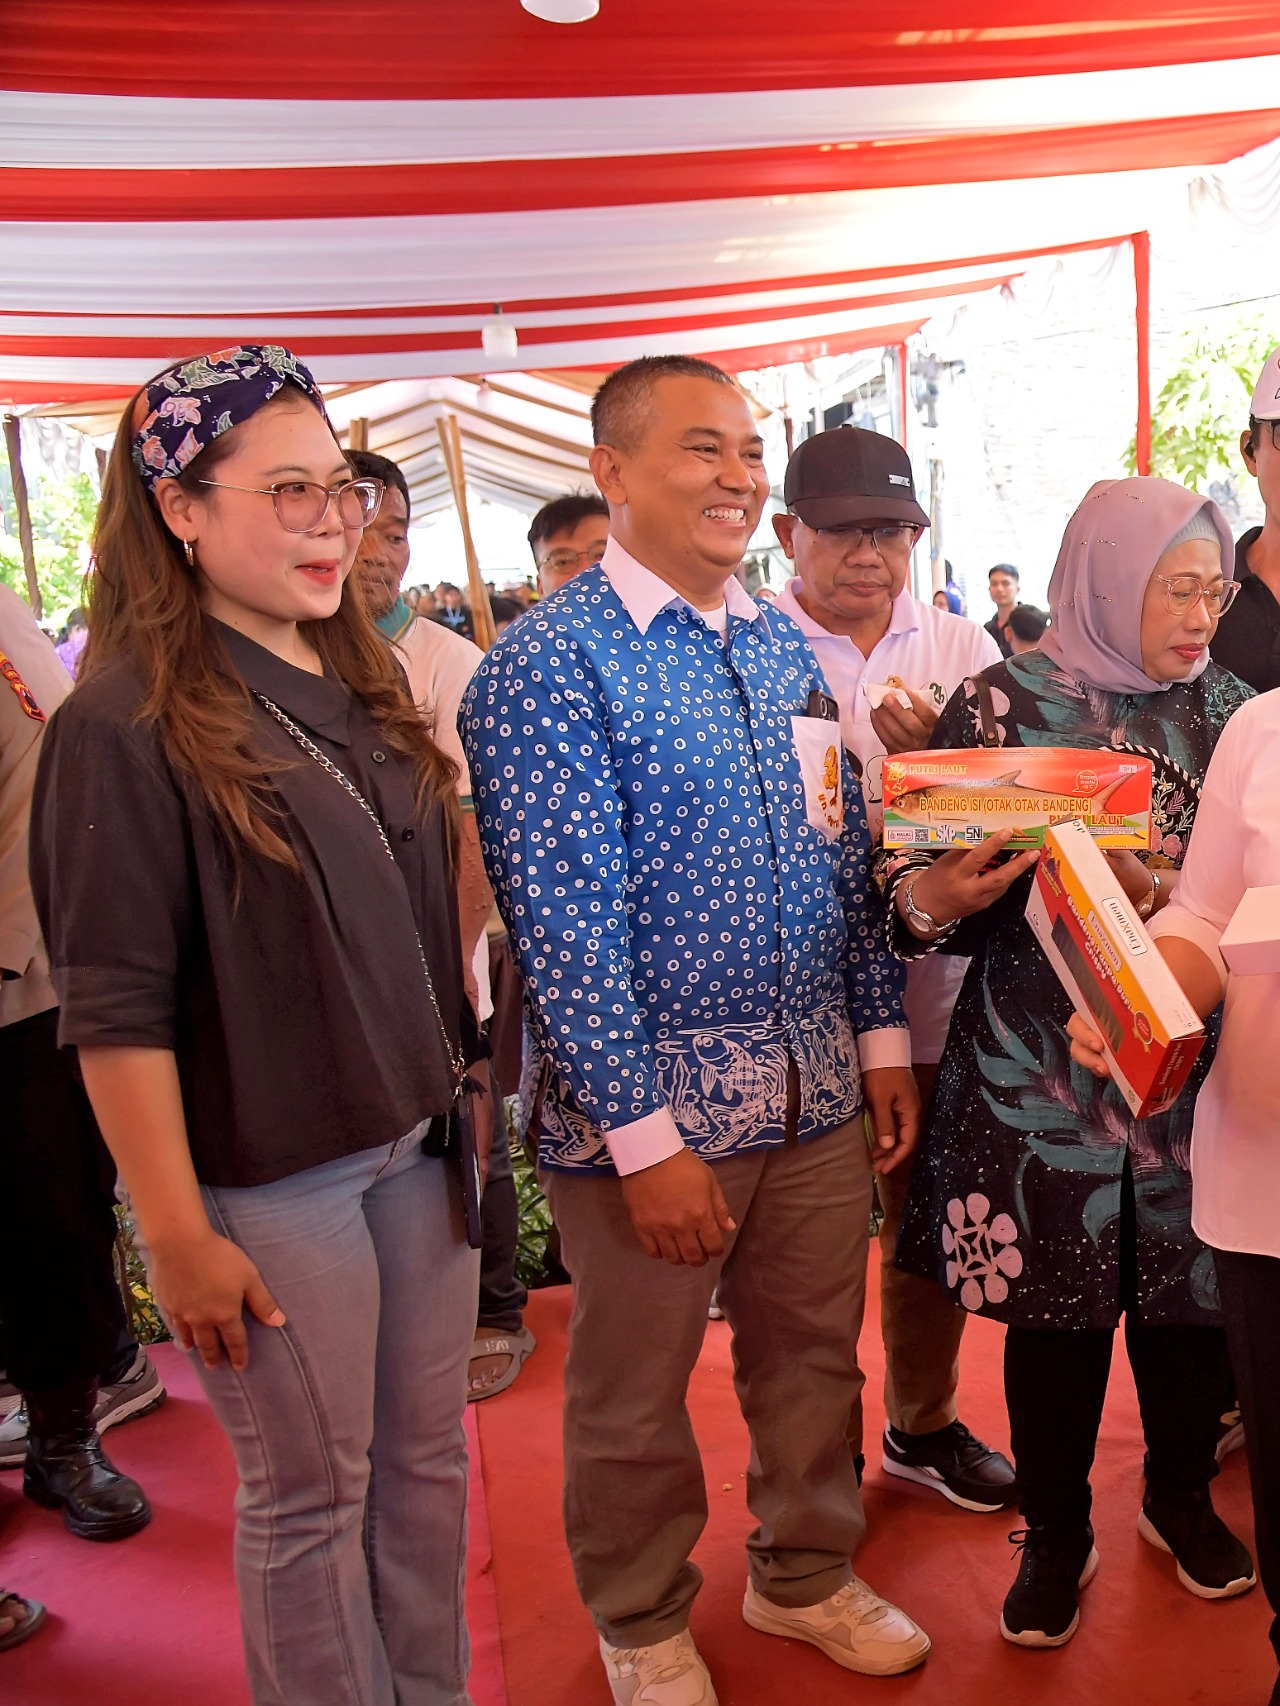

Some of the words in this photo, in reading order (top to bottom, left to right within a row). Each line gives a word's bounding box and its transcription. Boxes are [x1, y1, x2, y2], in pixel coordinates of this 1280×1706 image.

[909, 765, 938, 774] PUTRI
[941, 765, 966, 774] LAUT
[920, 798, 967, 811] BANDENG
[970, 799, 981, 811] ISI
[983, 798, 1012, 813] (OTAK
[1015, 799, 1040, 811] OTAK
[1043, 798, 1092, 813] BANDENG)
[1091, 815, 1125, 825] LAUT
[938, 825, 956, 843] SKP
[966, 827, 983, 839] SNI
